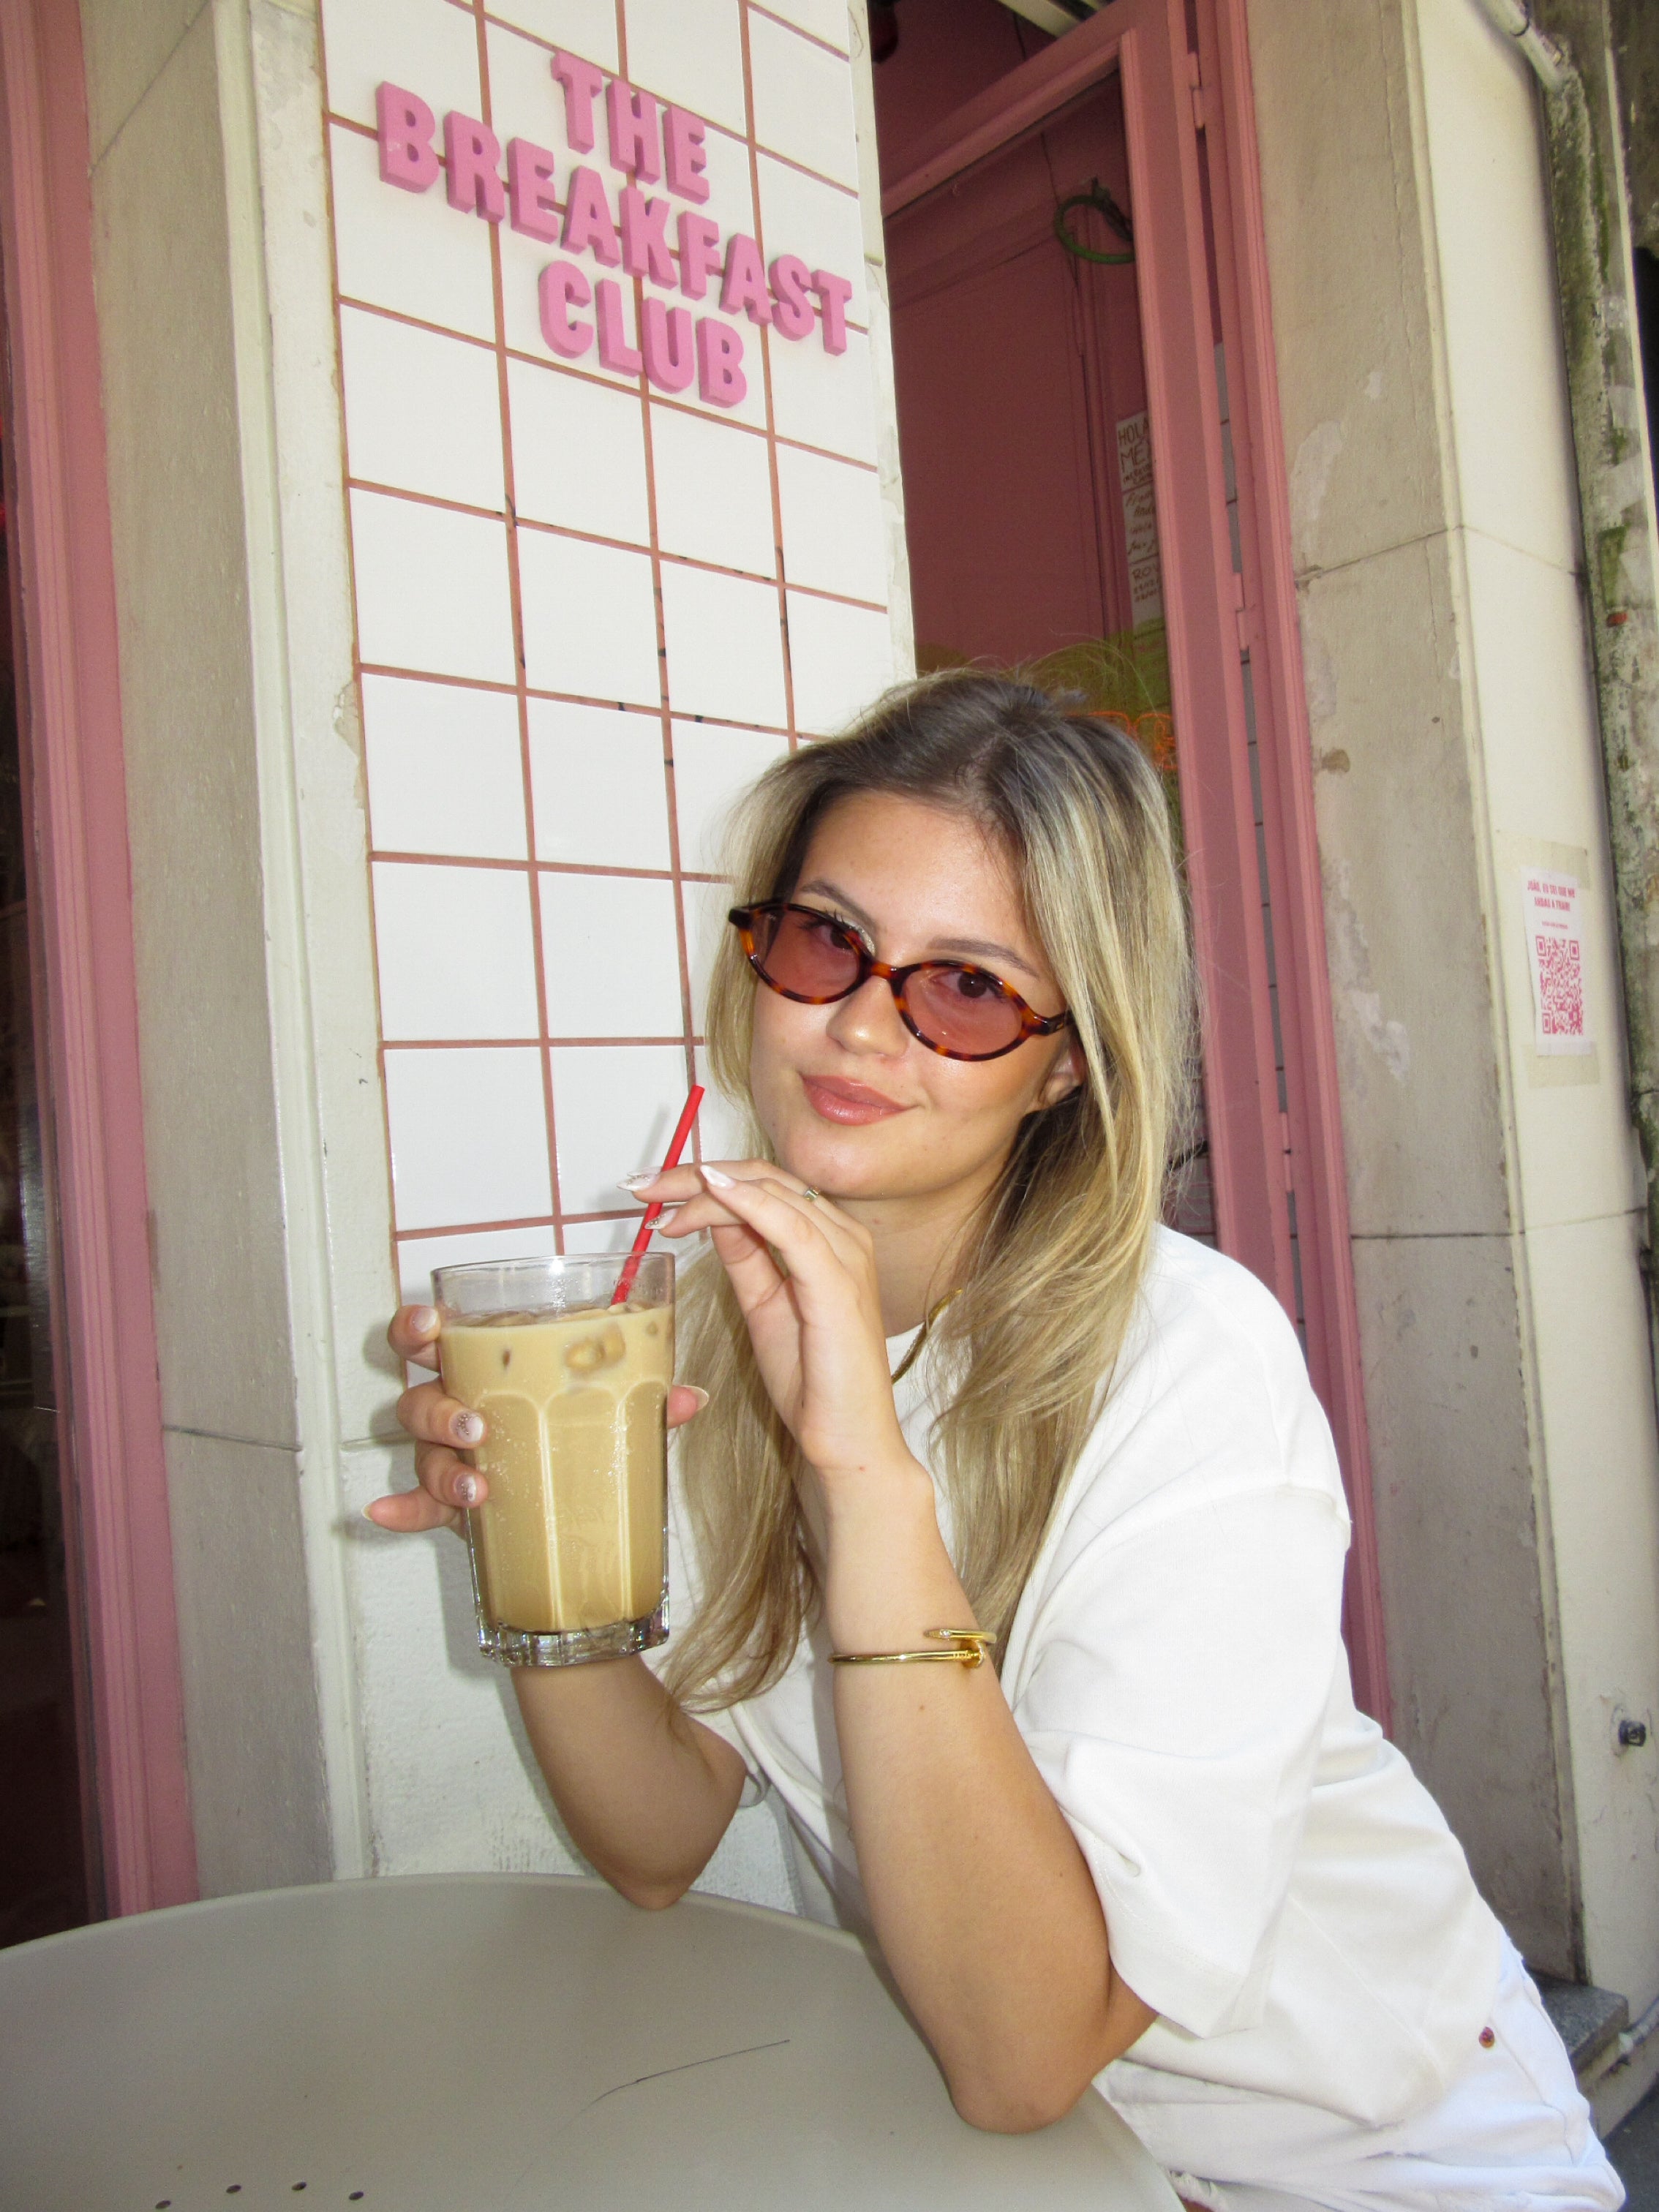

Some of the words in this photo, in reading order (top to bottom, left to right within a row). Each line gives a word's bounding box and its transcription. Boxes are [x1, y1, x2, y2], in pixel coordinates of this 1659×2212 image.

[552, 51, 710, 205] THE
[375, 80, 853, 356] BREAKFAST
[538, 260, 748, 408] CLUB
